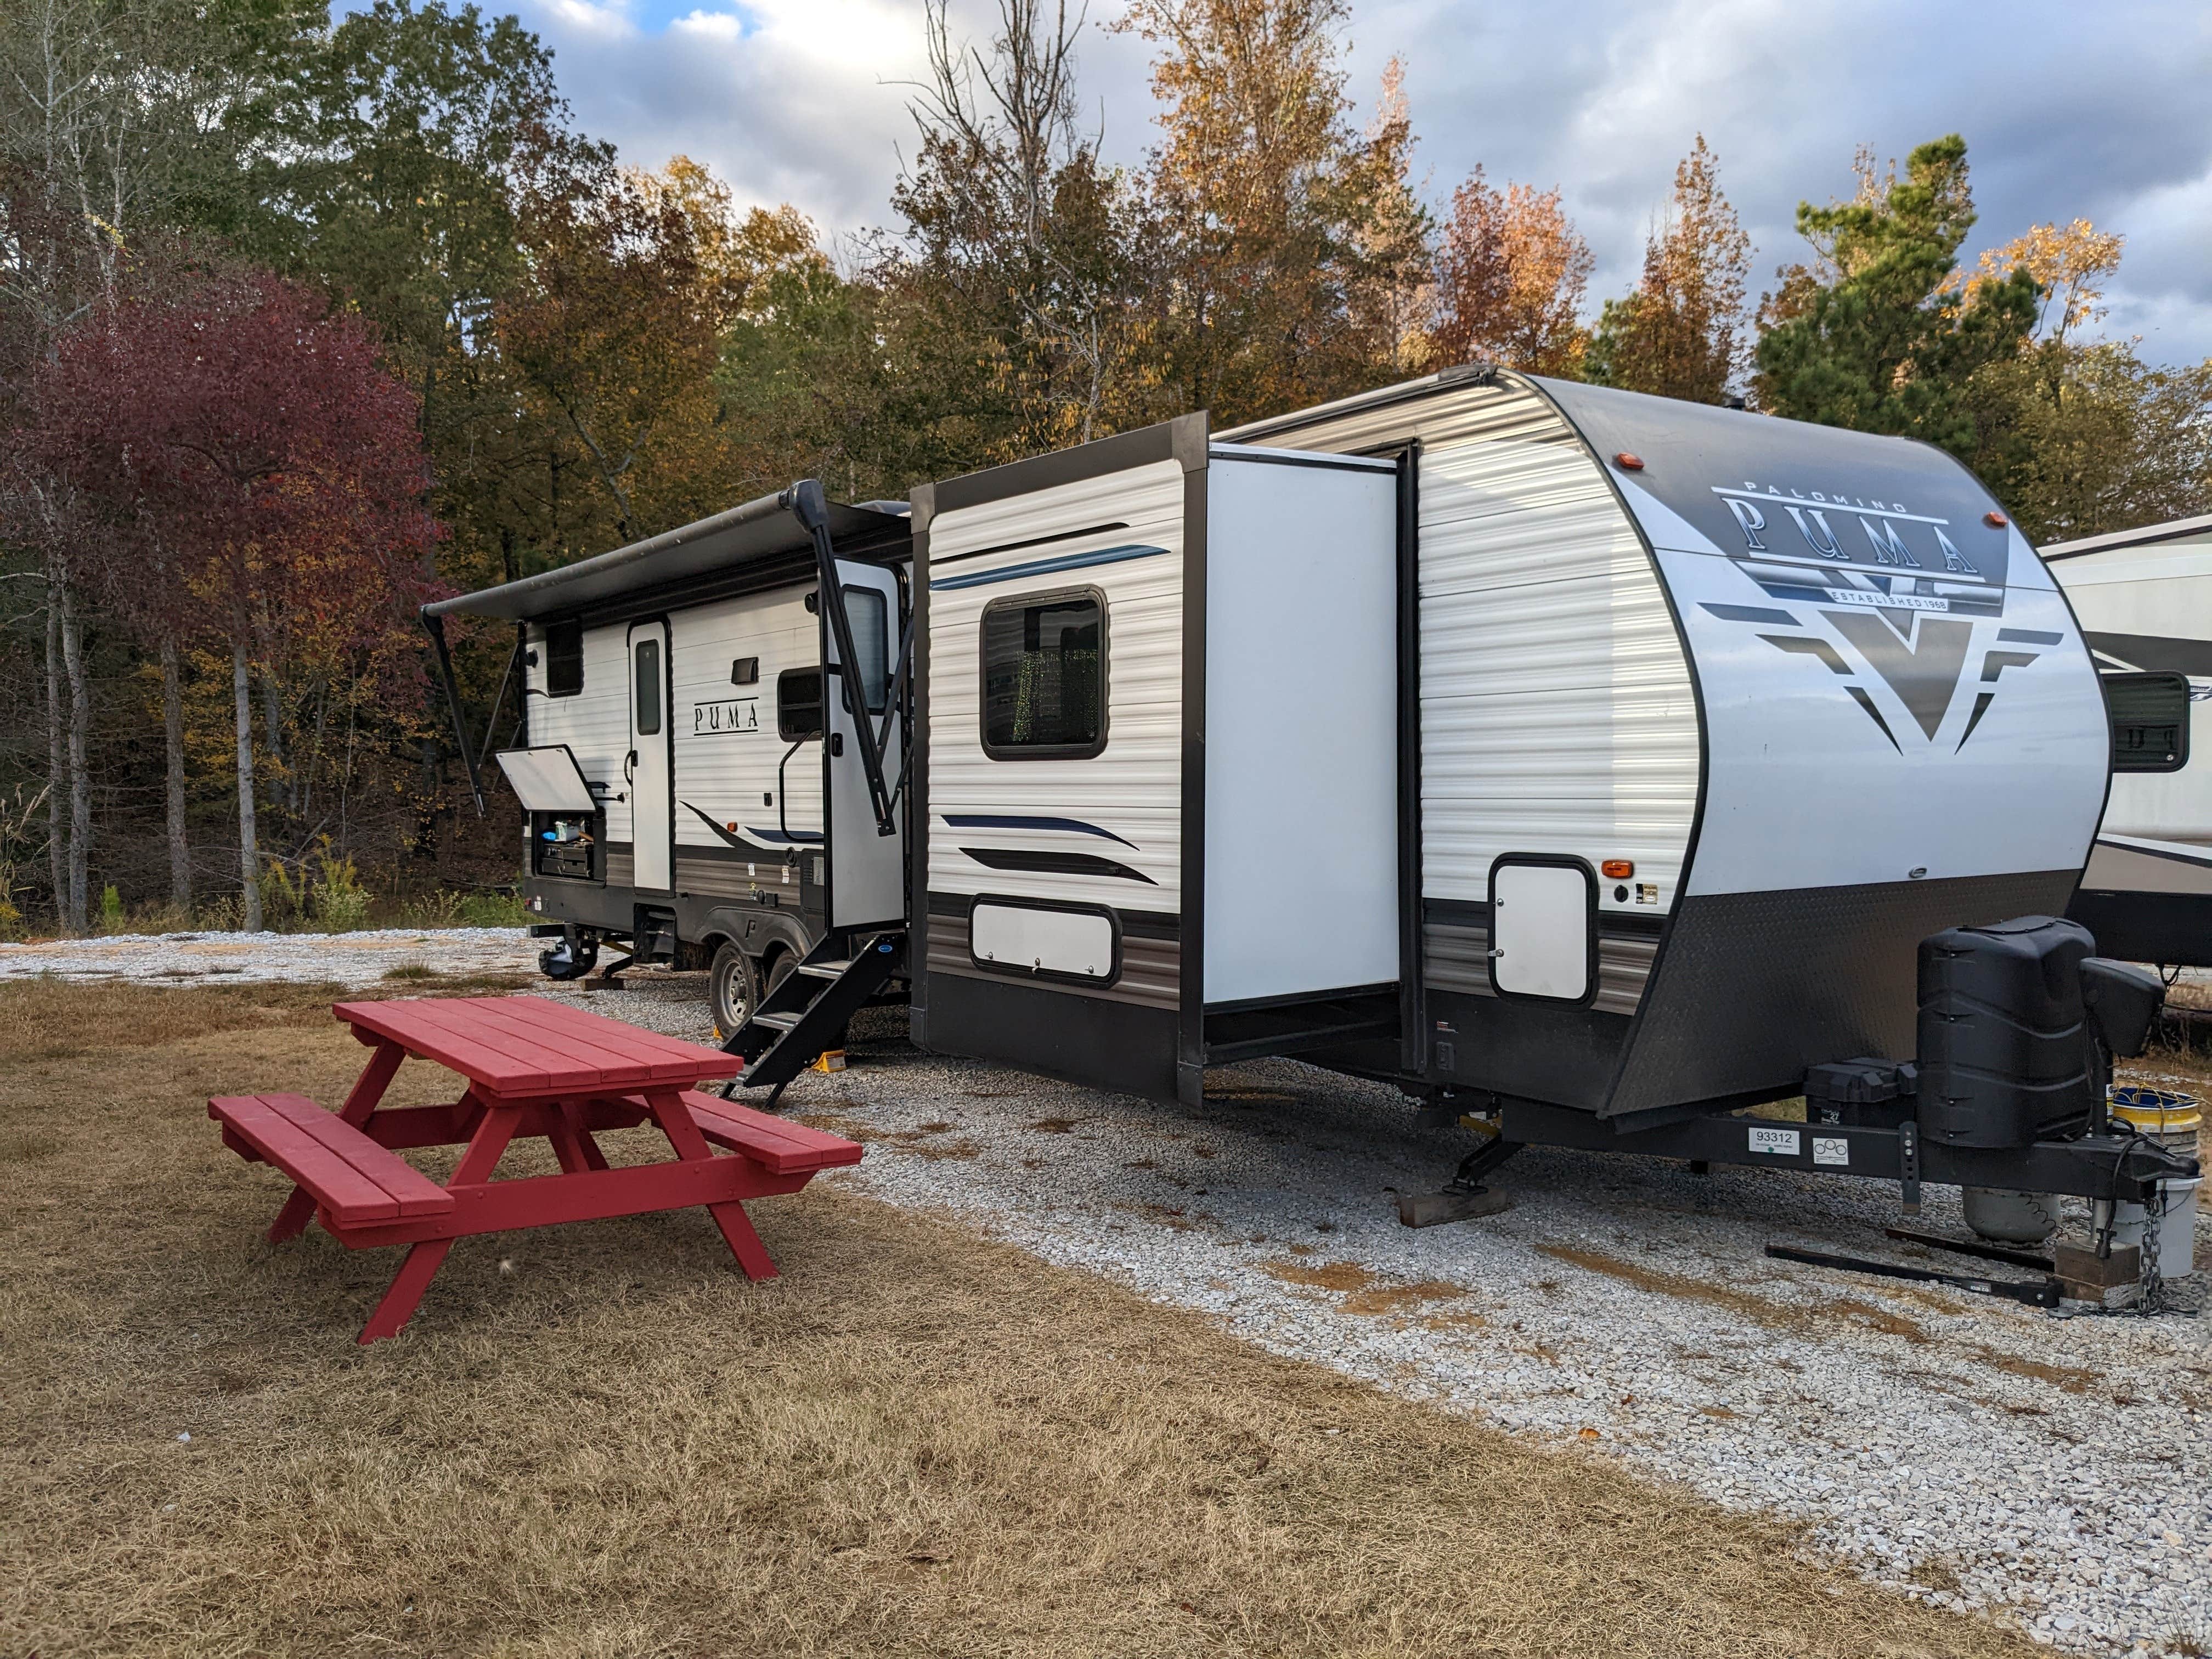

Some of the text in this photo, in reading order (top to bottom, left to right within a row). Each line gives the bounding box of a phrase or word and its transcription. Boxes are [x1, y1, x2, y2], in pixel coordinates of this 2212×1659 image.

[1744, 482, 1906, 513] PALOMINO
[1721, 497, 1978, 573] PUMA
[1831, 592, 1946, 609] ESTABLISHED 1968
[695, 702, 758, 731] PUMA
[1757, 1131, 1792, 1143] 93312
